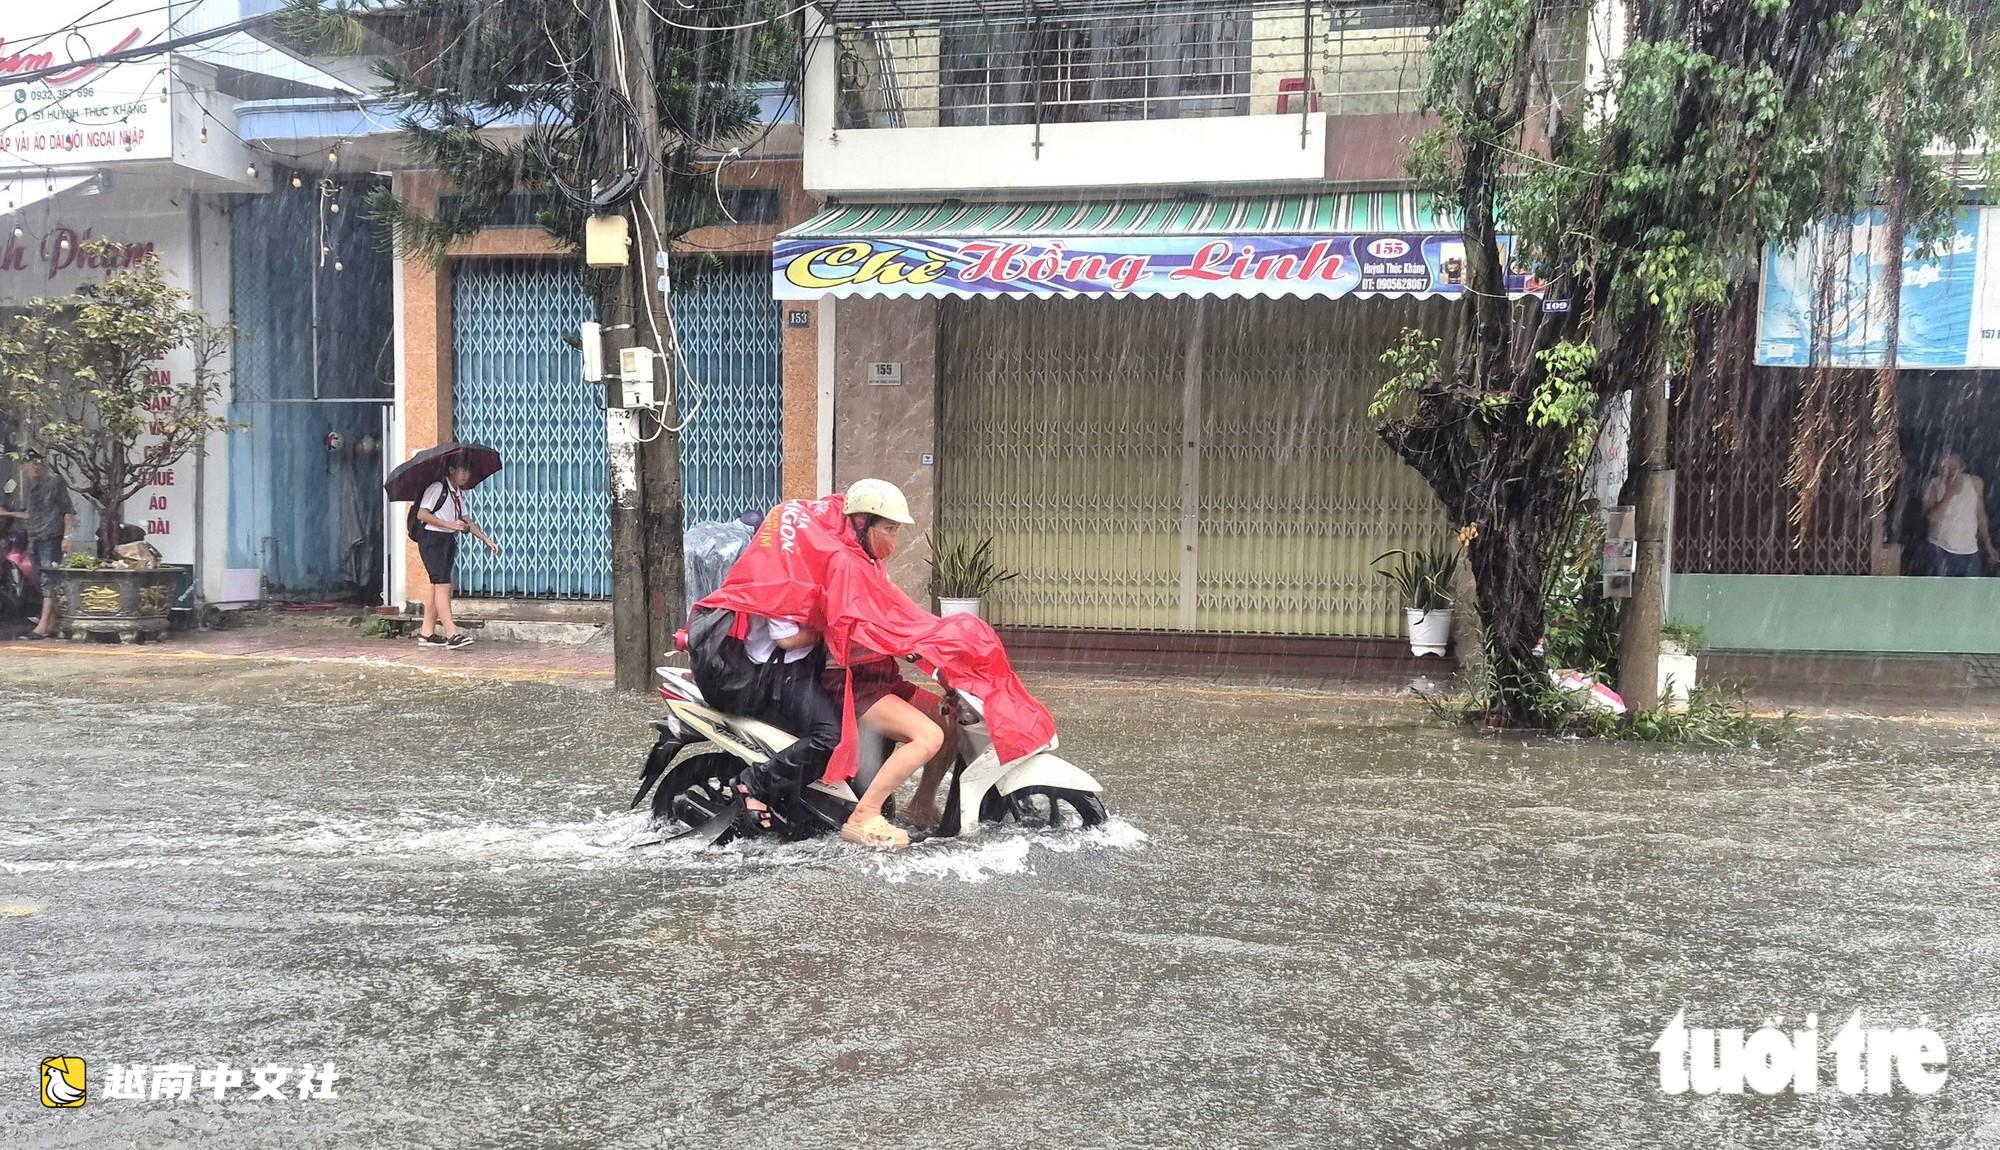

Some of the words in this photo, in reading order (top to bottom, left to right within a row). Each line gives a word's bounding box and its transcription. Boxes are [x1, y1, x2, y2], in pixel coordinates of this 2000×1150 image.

[1374, 242, 1404, 255] 155
[785, 241, 951, 289] Chè
[957, 240, 1153, 290] Hồng
[1169, 240, 1351, 281] Linh
[1363, 262, 1385, 275] Huỳnh
[1545, 301, 1568, 310] 109
[789, 312, 808, 324] 153
[1981, 329, 1995, 339] 157
[874, 363, 893, 375] 155
[148, 492, 168, 511] ÁO
[147, 517, 171, 535] DÀI
